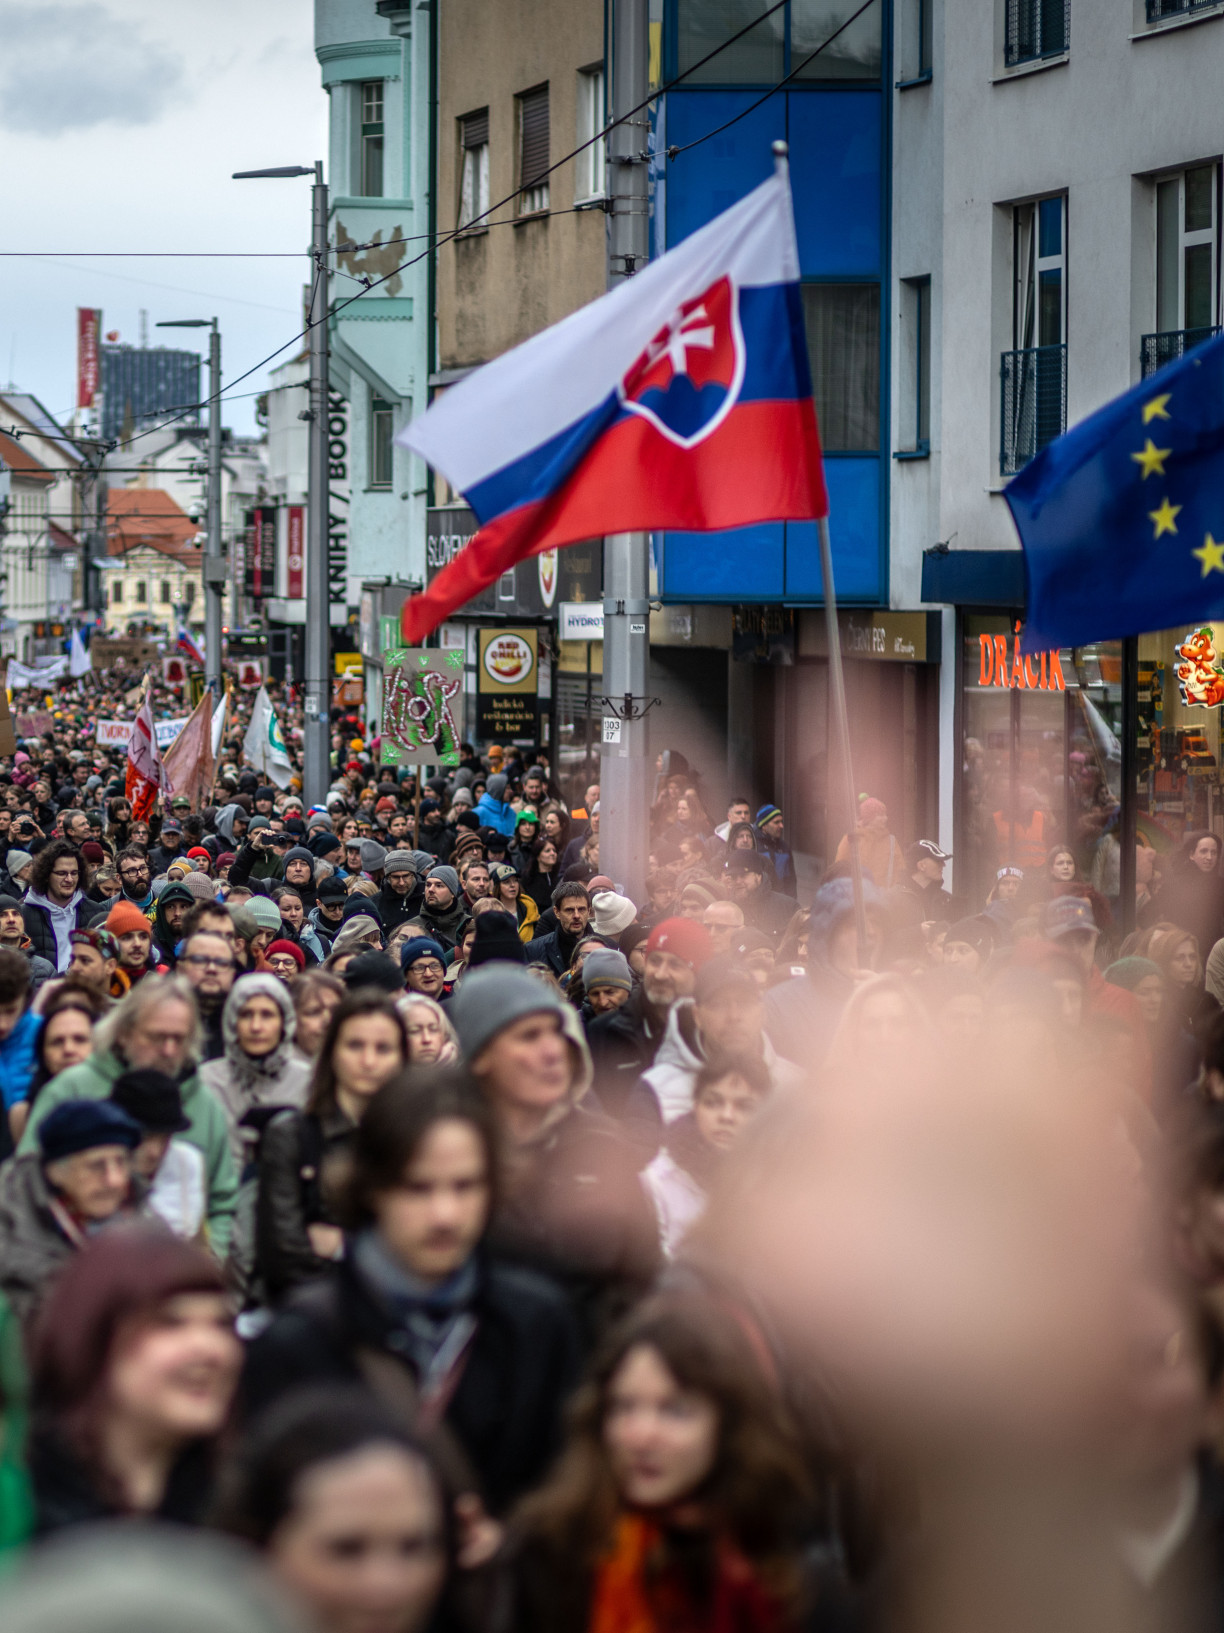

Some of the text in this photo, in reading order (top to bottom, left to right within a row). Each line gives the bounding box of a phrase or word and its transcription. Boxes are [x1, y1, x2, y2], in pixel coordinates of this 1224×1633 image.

[328, 384, 348, 480] BOOK
[328, 513, 347, 605] KNIHY
[490, 650, 528, 660] CHILLI
[497, 641, 520, 650] RED
